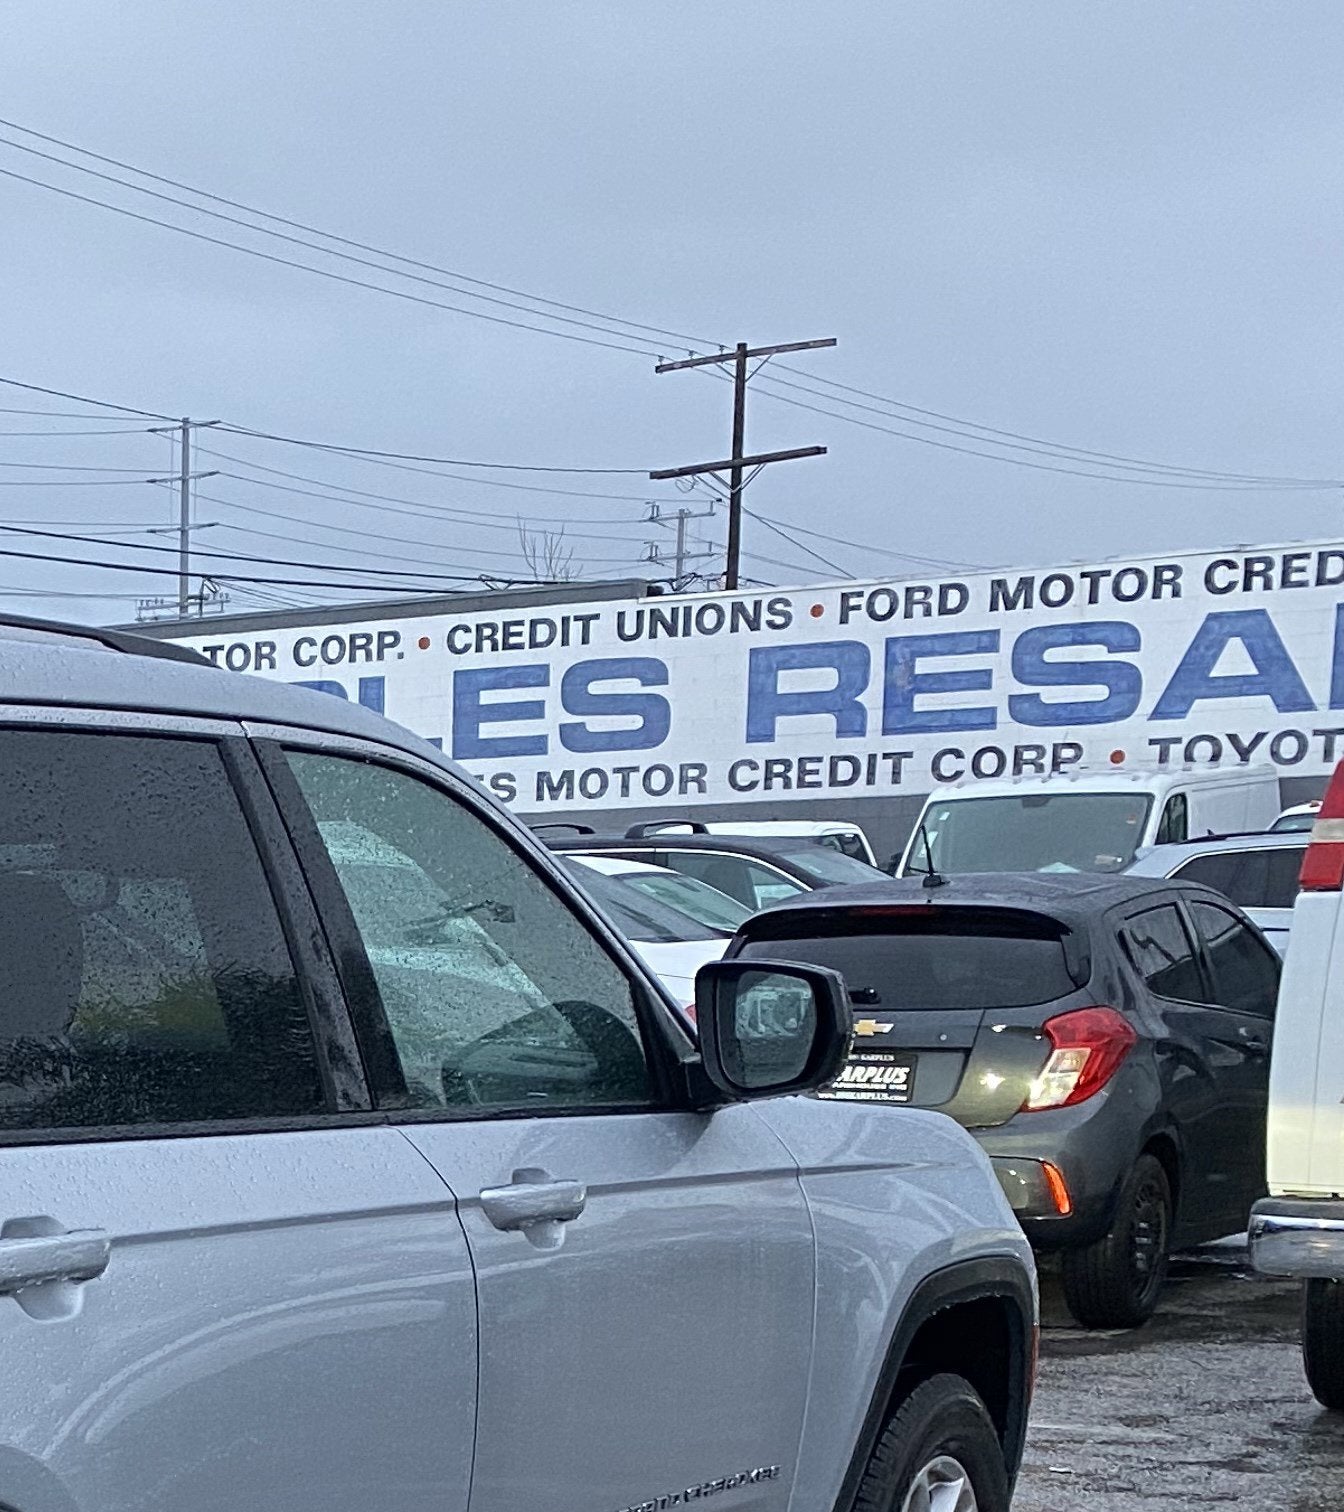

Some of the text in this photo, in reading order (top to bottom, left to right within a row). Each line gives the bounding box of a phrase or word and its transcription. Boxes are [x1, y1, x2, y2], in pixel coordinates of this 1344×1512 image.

[201, 549, 1344, 673] TOR CORP. CREDIT UNIONS FORD MOTOR CRED
[745, 602, 1344, 744] RESA
[535, 762, 708, 802] MOTOR
[728, 751, 914, 792] CREDIT
[836, 1065, 911, 1084] ARPLUS
